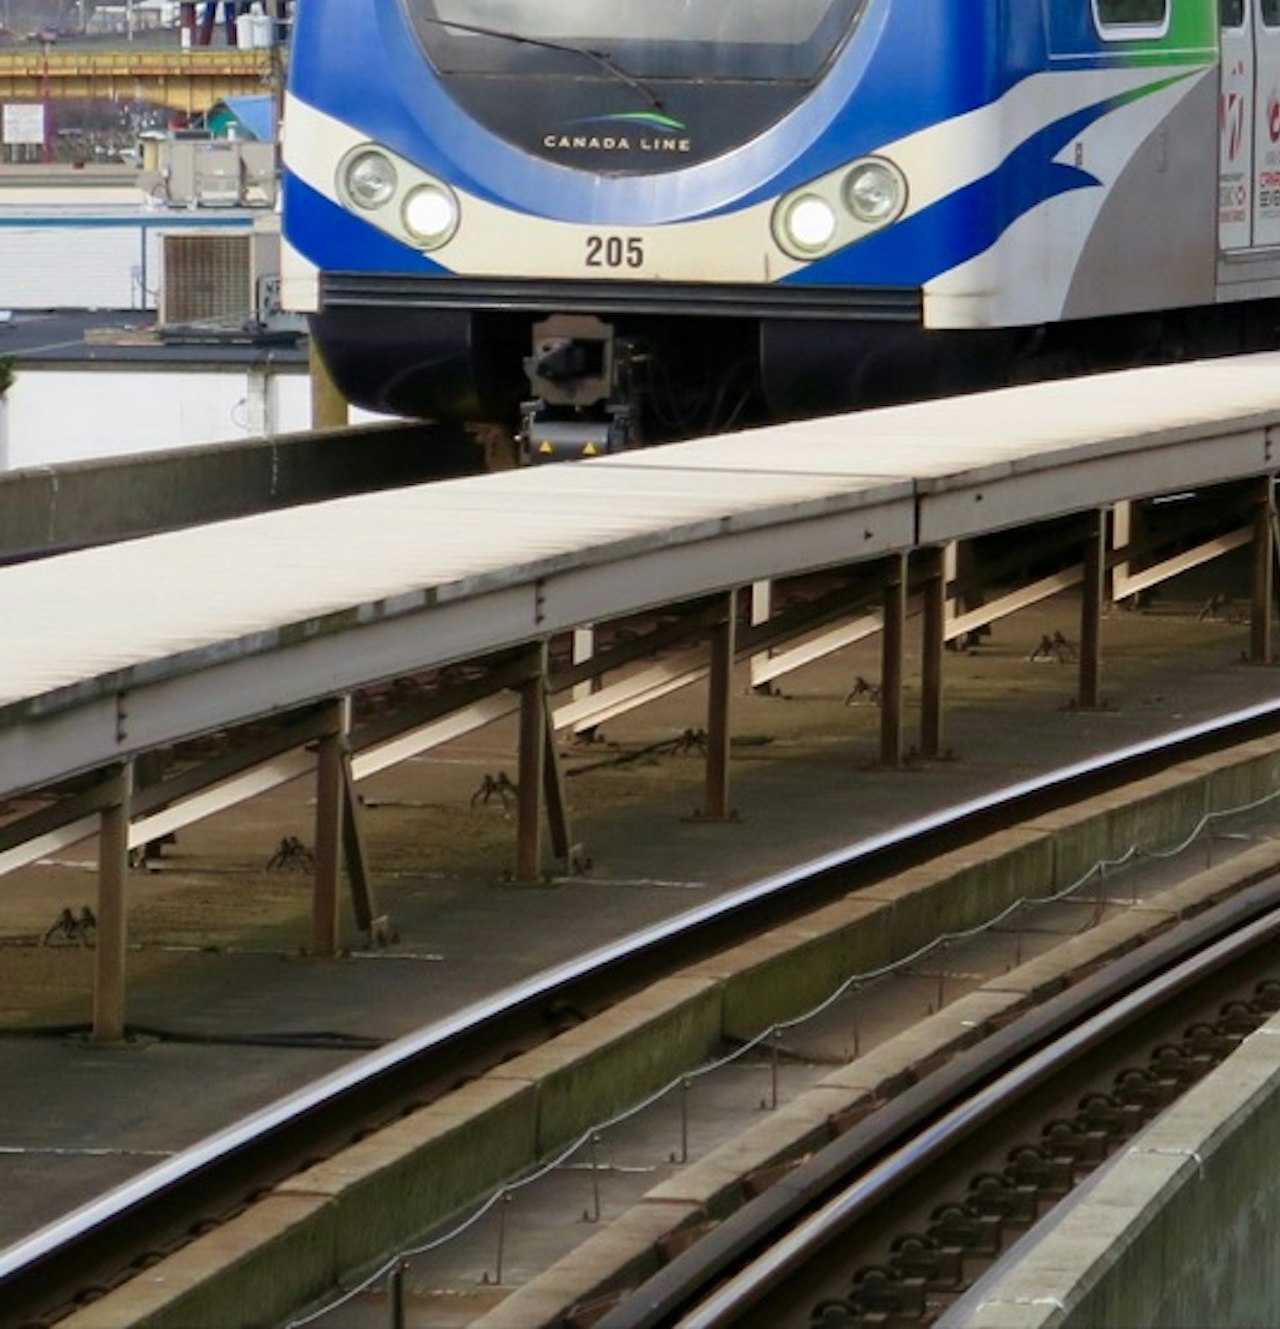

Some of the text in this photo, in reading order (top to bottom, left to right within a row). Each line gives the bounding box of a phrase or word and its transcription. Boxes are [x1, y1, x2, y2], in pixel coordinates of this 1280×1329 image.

[544, 135, 691, 151] CANADA LINE
[586, 236, 644, 267] 205
